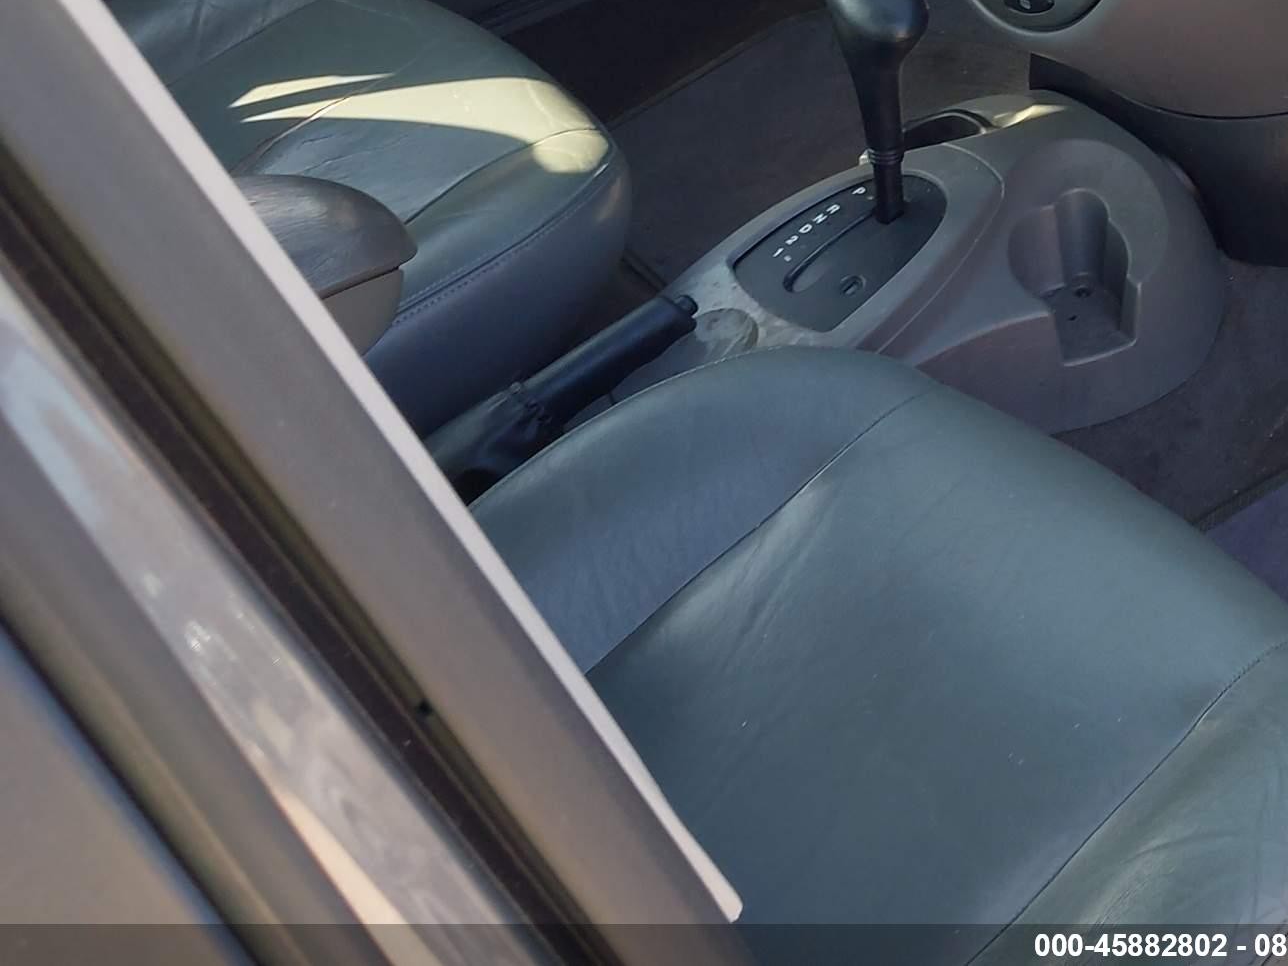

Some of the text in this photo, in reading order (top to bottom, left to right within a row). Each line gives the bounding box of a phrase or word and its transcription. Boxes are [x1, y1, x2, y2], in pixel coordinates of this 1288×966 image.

[851, 186, 867, 195] P
[826, 204, 841, 214] R
[812, 213, 828, 224] N
[798, 223, 813, 234] D
[785, 235, 799, 245] 2
[772, 247, 784, 258] 1
